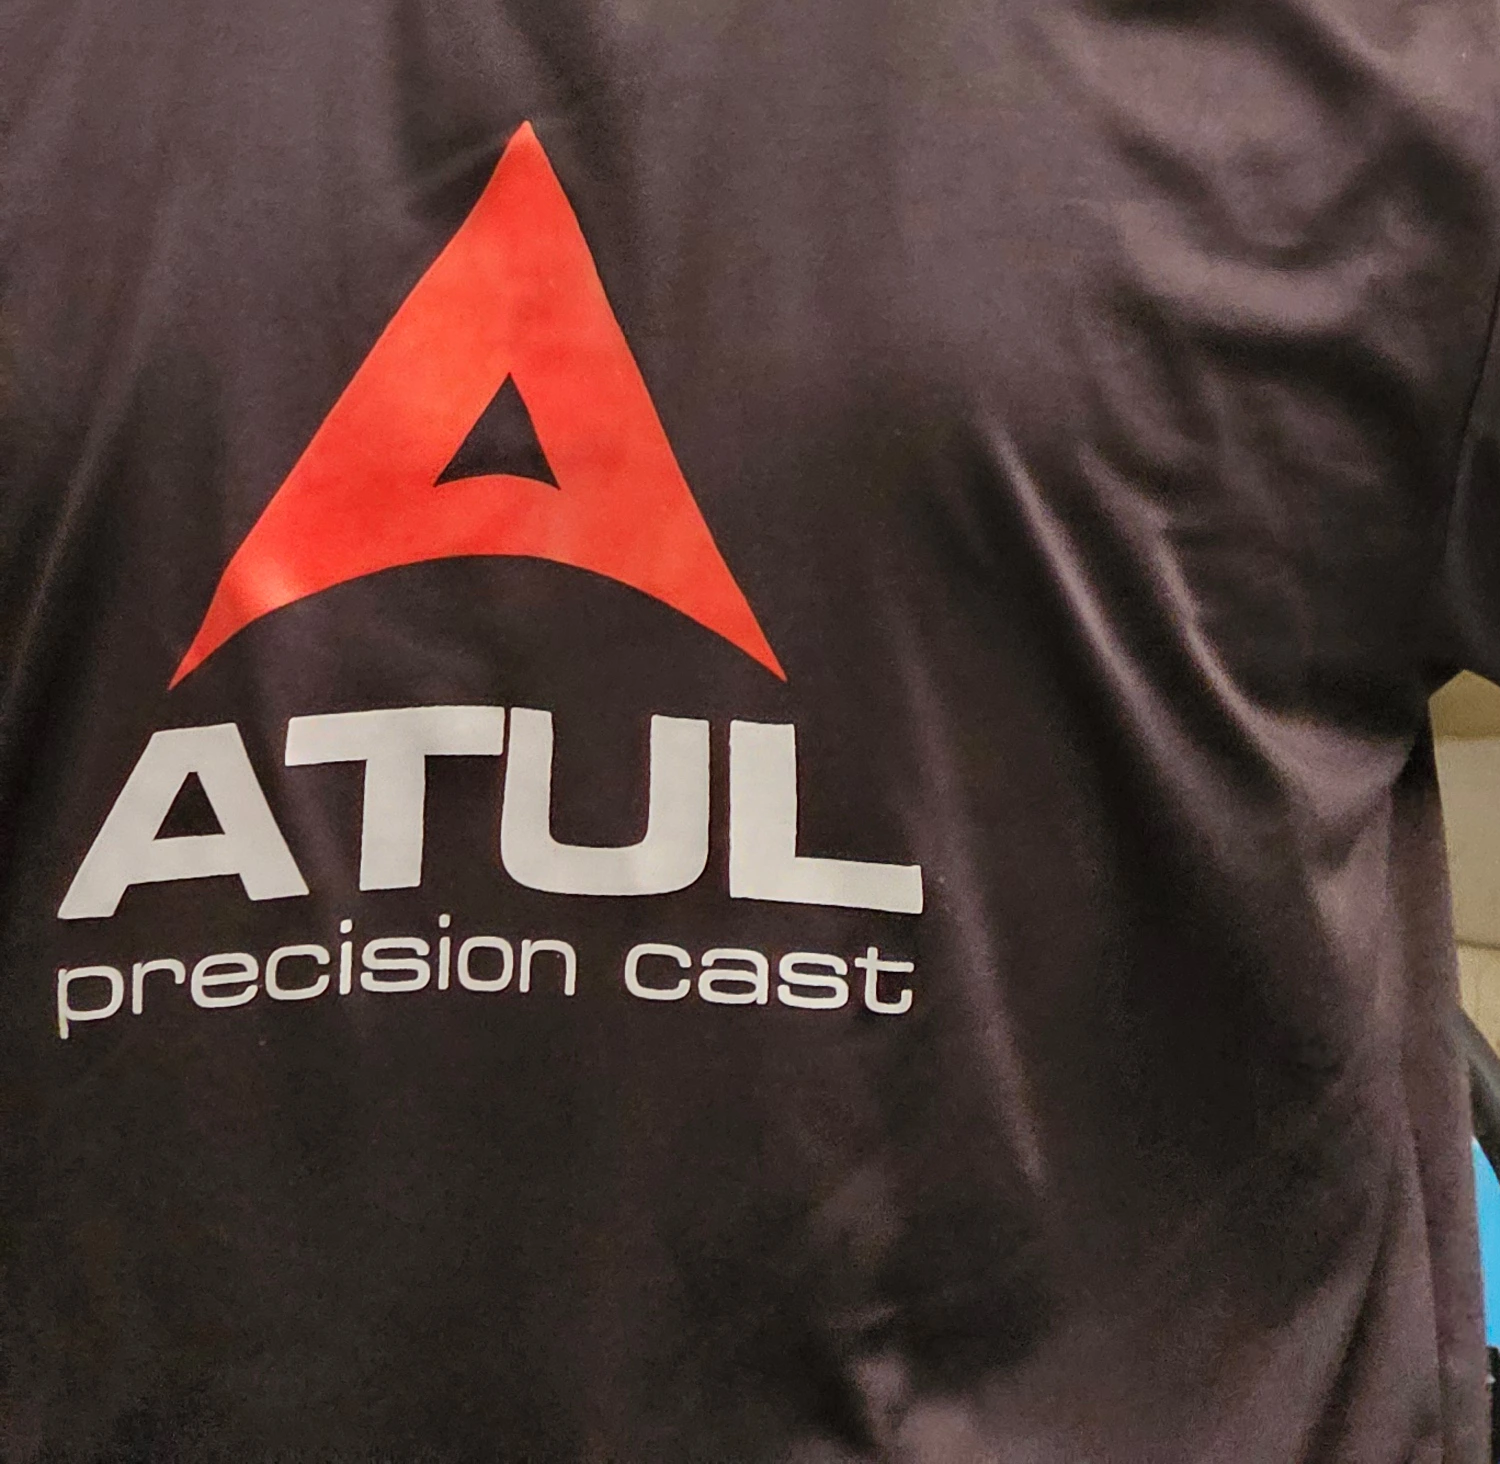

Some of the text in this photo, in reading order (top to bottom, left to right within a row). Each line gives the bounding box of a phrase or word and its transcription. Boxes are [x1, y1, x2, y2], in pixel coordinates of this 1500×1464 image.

[58, 706, 923, 919] ATUL
[58, 914, 915, 1039] precision cast
